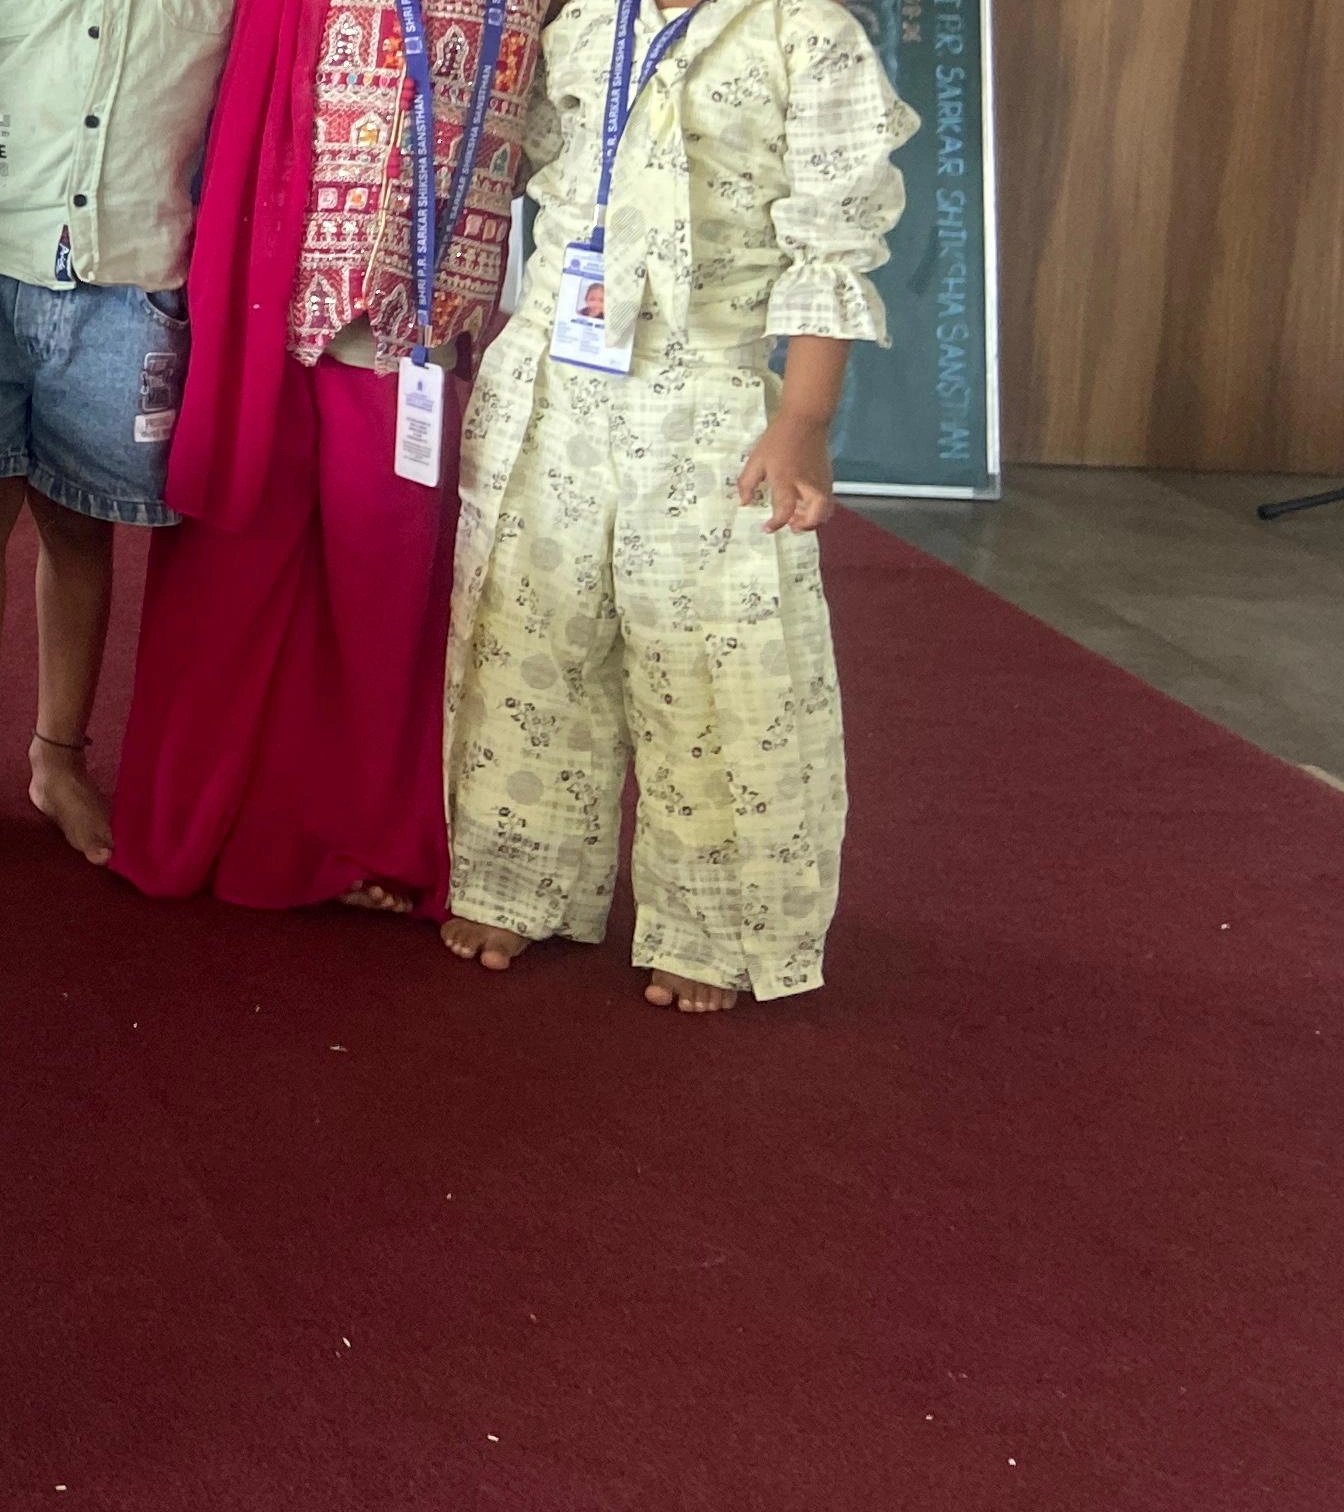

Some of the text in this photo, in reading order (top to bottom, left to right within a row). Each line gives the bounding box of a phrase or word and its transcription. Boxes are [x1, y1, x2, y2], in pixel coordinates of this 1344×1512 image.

[402, 6, 416, 34] SHRI
[414, 94, 429, 156] SANSTHAN
[934, 64, 967, 178] SARKAR
[416, 156, 429, 206] SHIKSHA
[416, 206, 428, 253] SARKAR
